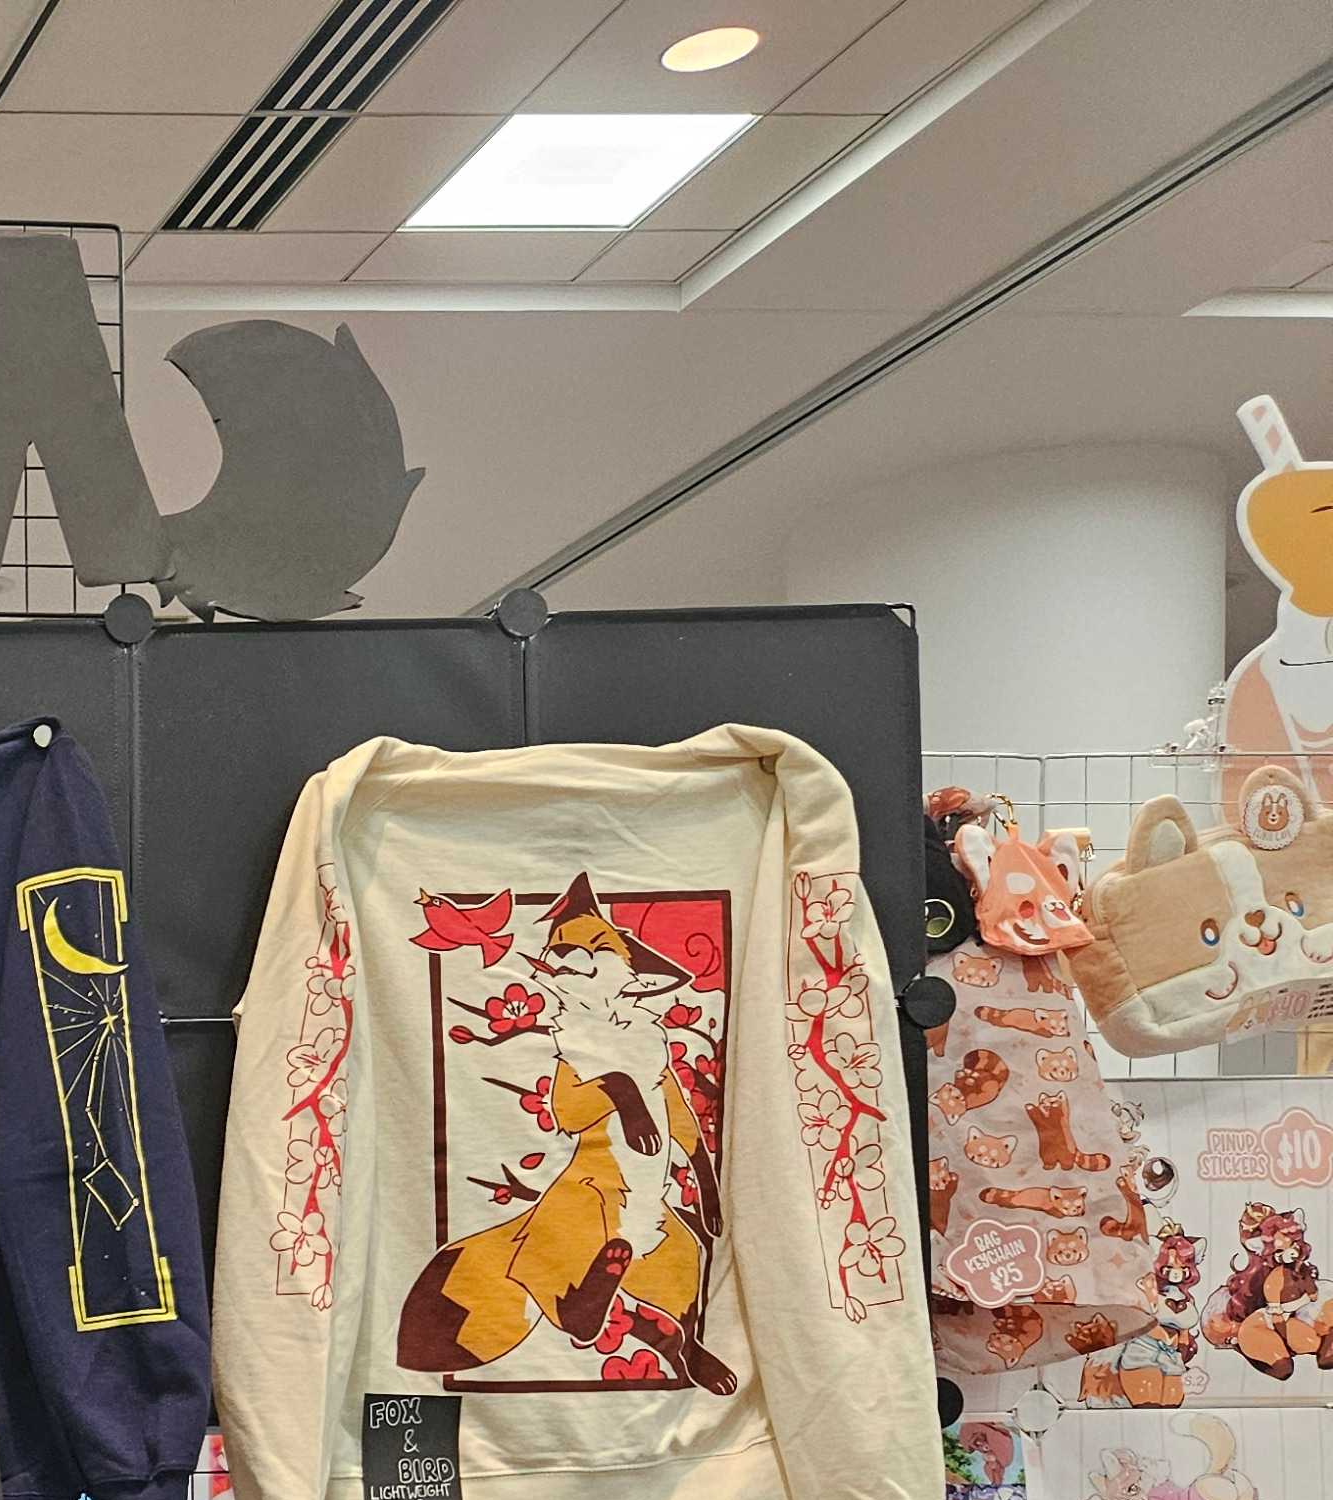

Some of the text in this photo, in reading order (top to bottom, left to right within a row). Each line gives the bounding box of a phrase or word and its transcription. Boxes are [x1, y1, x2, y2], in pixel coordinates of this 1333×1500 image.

[1210, 1132, 1256, 1154] PINUP
[1277, 1129, 1323, 1176] $10
[1201, 1155, 1267, 1177] STICKERS
[973, 1230, 1002, 1253] BAG
[964, 1239, 1028, 1275] KEYCHAIN
[989, 1261, 1024, 1293] $25
[369, 1397, 423, 1429] FOX
[403, 1429, 421, 1453] &
[398, 1458, 456, 1484] BIRD
[370, 1483, 452, 1500] LIGHTWEIGHT
